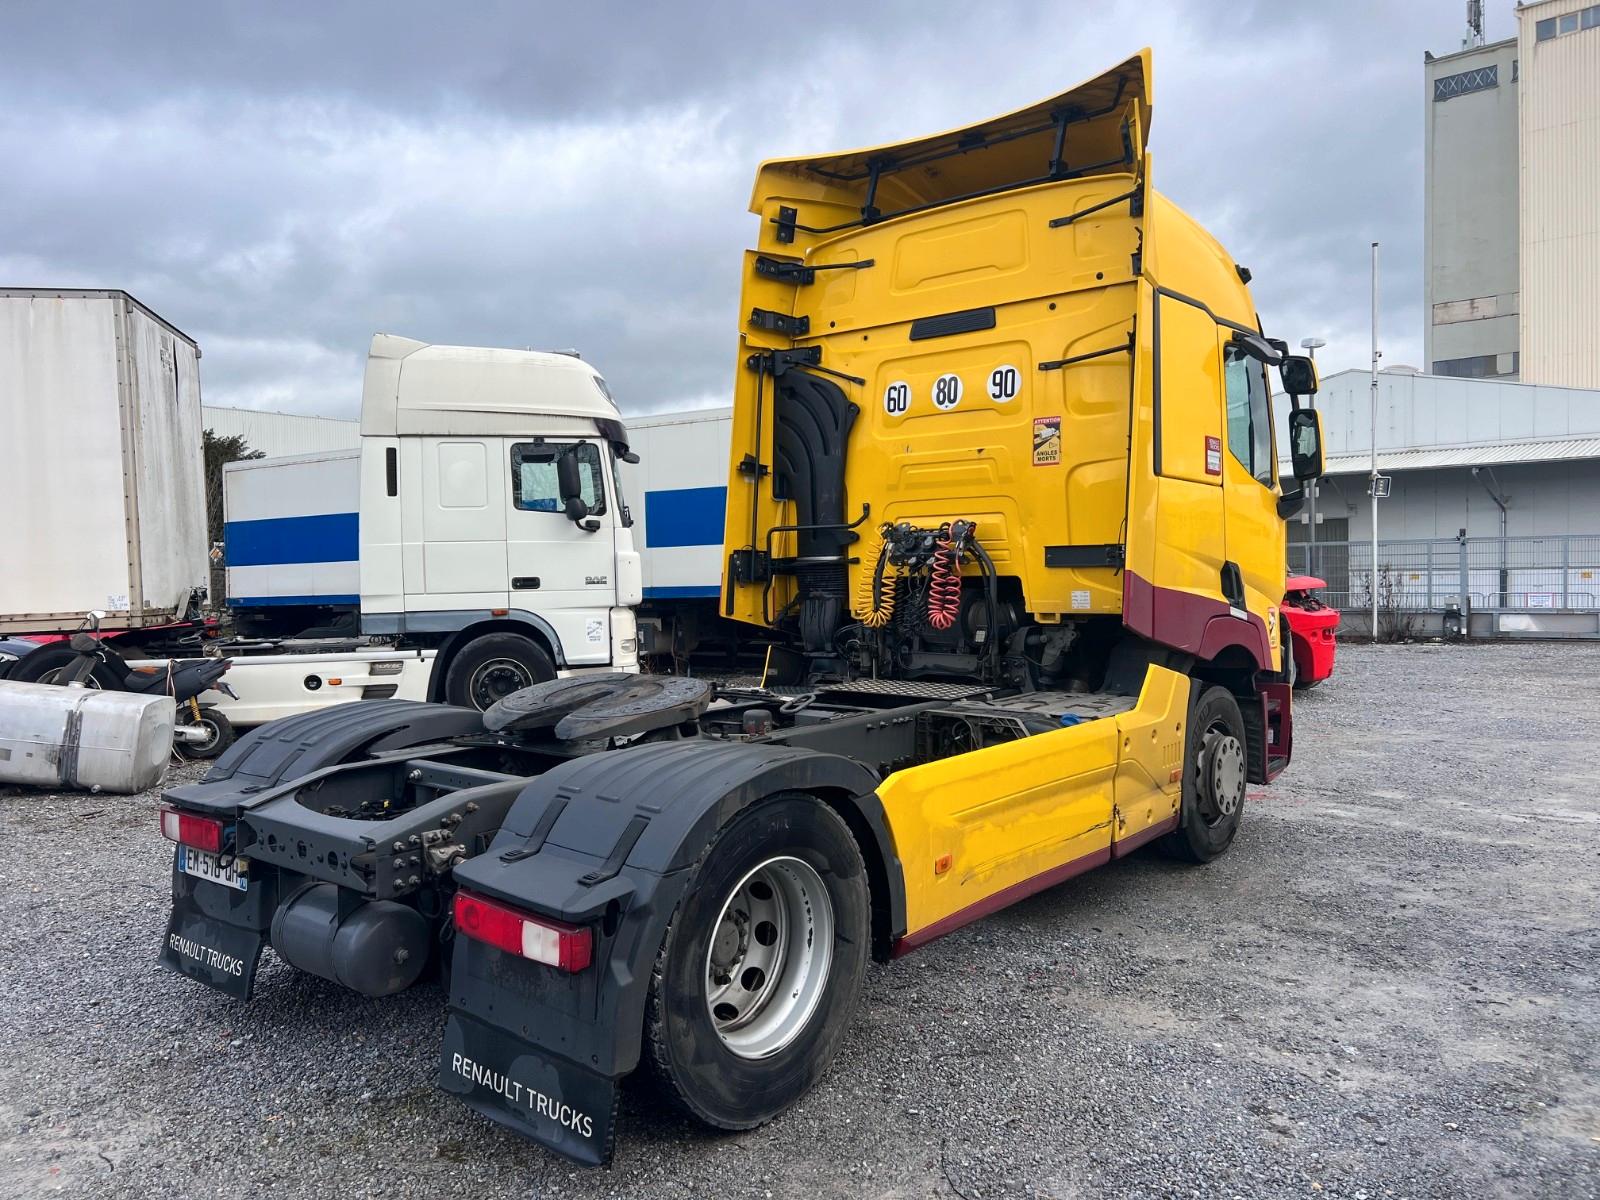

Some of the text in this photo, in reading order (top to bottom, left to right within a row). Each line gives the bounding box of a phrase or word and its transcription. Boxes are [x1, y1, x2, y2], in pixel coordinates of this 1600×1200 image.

[887, 368, 1016, 413] 60 80 90
[169, 933, 243, 976] RENAULT TRUCKS
[452, 1052, 593, 1138] RENAULT TRUCKS
